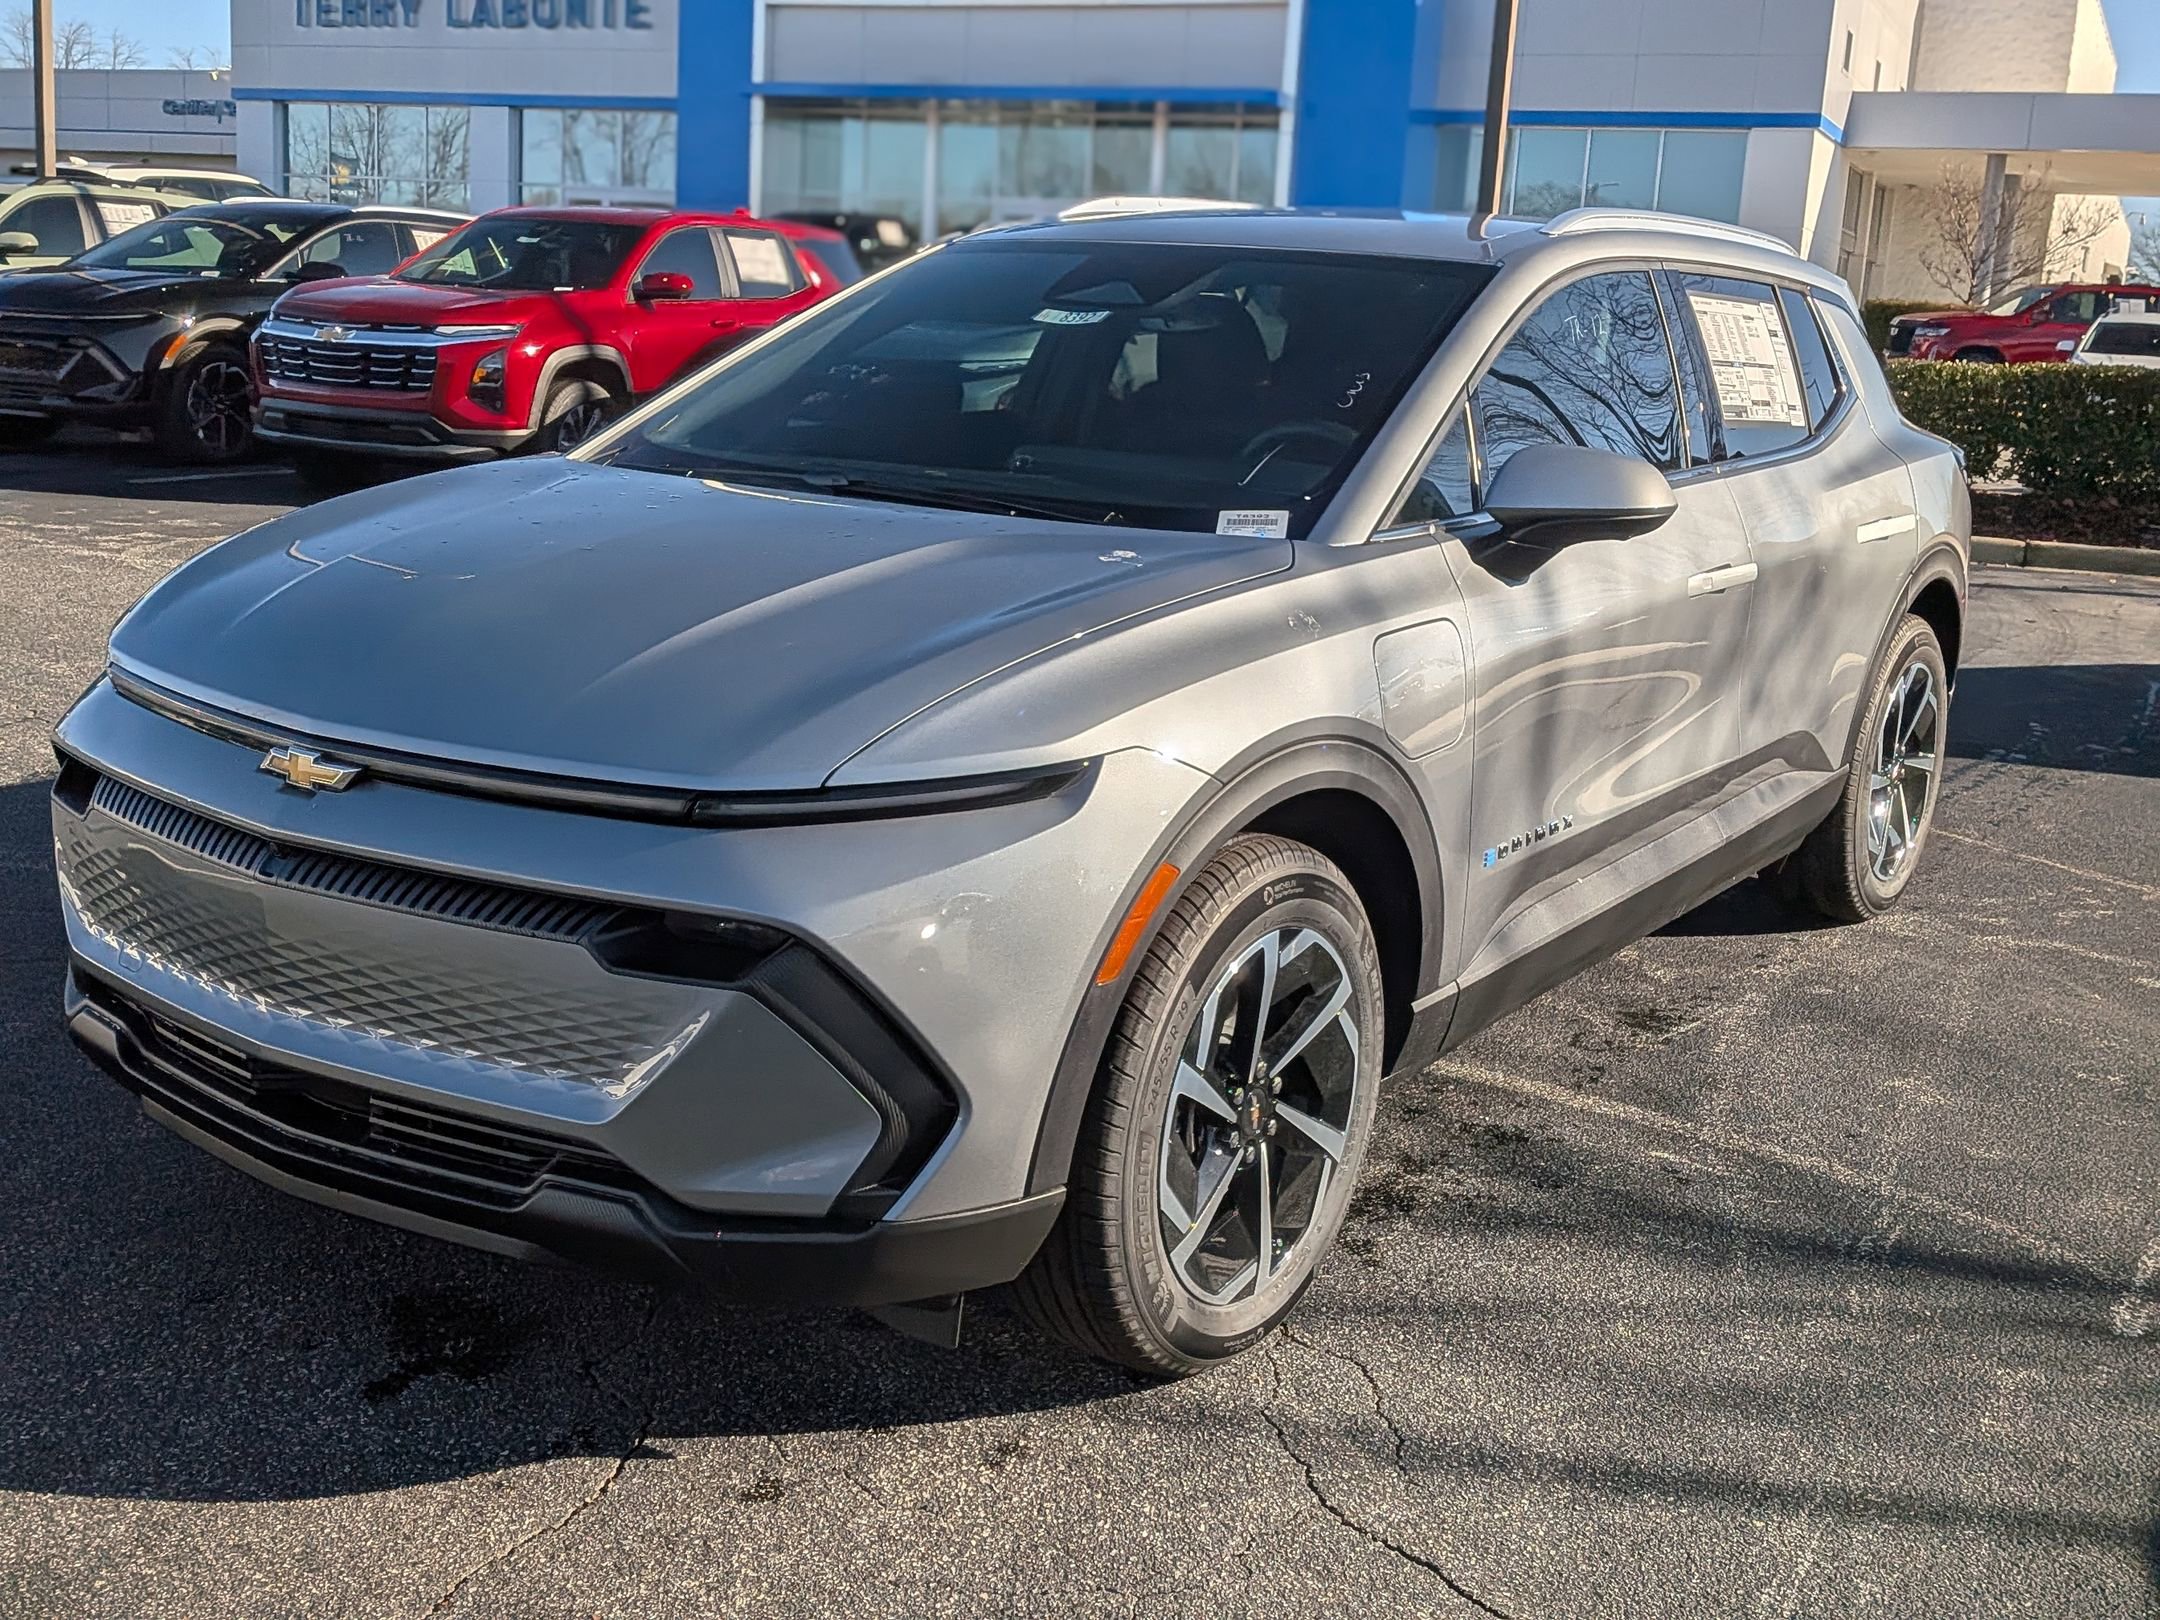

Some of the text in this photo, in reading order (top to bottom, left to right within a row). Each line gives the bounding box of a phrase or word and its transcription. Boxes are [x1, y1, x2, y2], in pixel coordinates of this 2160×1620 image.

[296, 0, 653, 29] TERRY LABONTE
[1148, 1000, 1189, 1115] 245/55 R 19
[1136, 1141, 1161, 1286] MICHELIN
